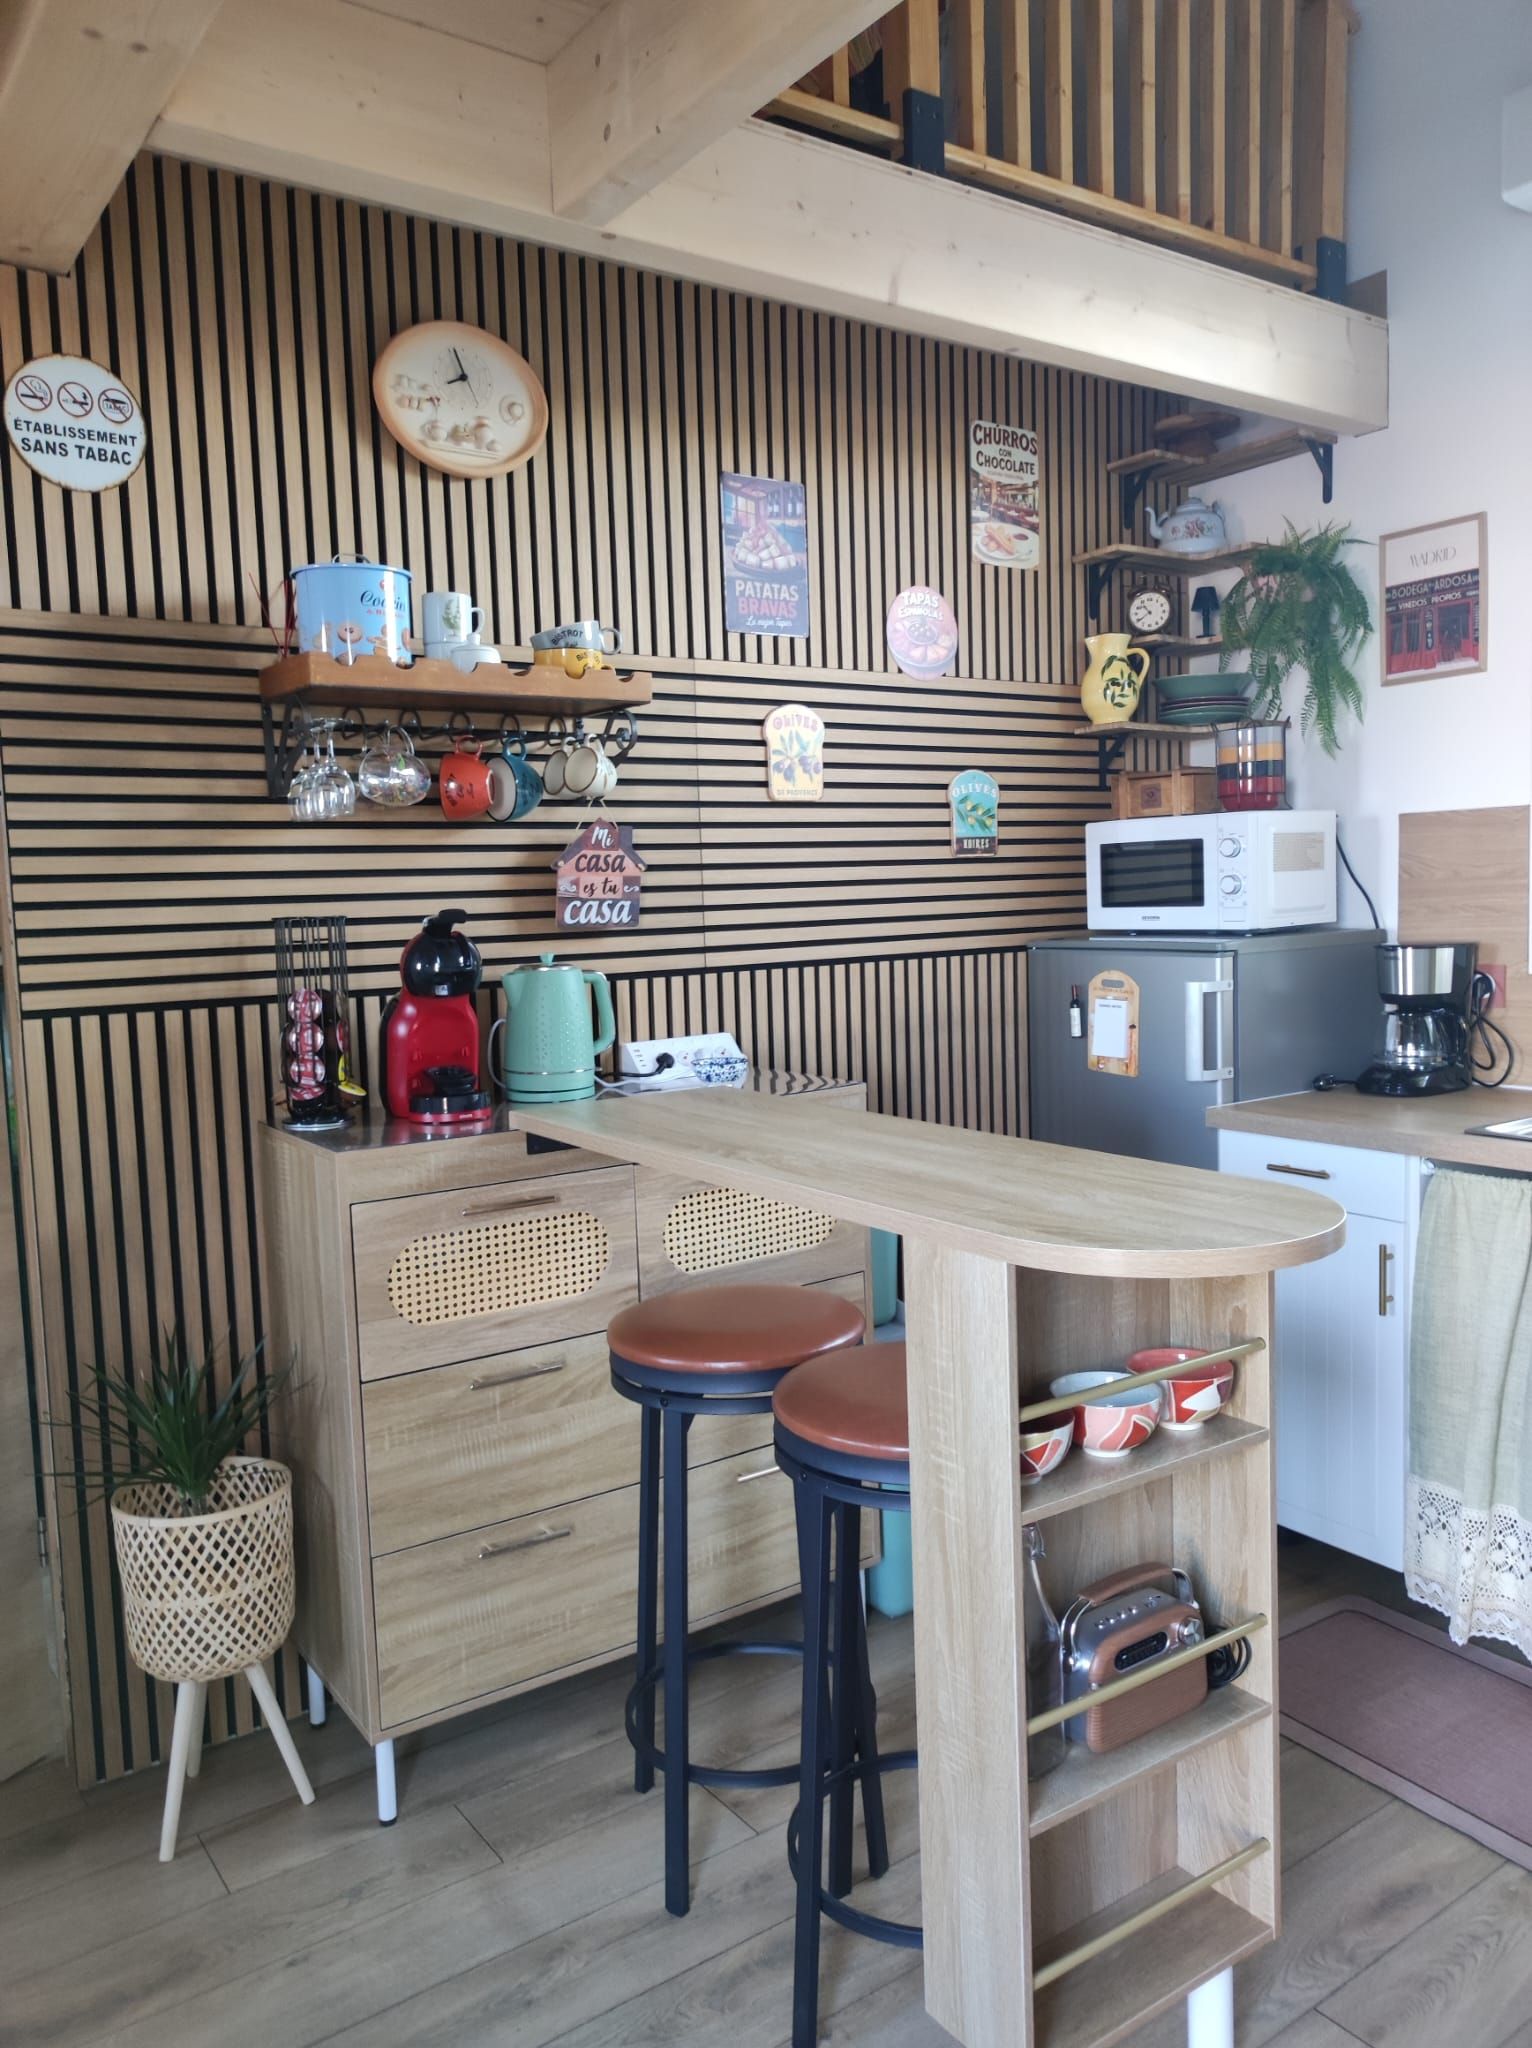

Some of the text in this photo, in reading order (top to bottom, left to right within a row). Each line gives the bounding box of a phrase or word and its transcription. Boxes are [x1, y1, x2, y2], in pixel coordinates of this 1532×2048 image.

[13, 417, 138, 447] ÉTABLISSEMENT
[21, 437, 132, 465] SANS TABAC
[999, 448, 1012, 458] CON
[976, 450, 1036, 475] CHOCOLATE
[735, 579, 800, 602] PATATAS
[1391, 583, 1429, 599] BODEGA
[1434, 573, 1473, 591] ARDOSA
[738, 597, 798, 619] BRAVAS
[901, 591, 939, 608] TAPAS
[551, 629, 584, 646] BISTROT
[952, 783, 997, 798] OLIVES
[591, 826, 614, 849] Mi
[575, 853, 625, 873] casa
[583, 876, 620, 898] es tu
[563, 900, 632, 925] casa
